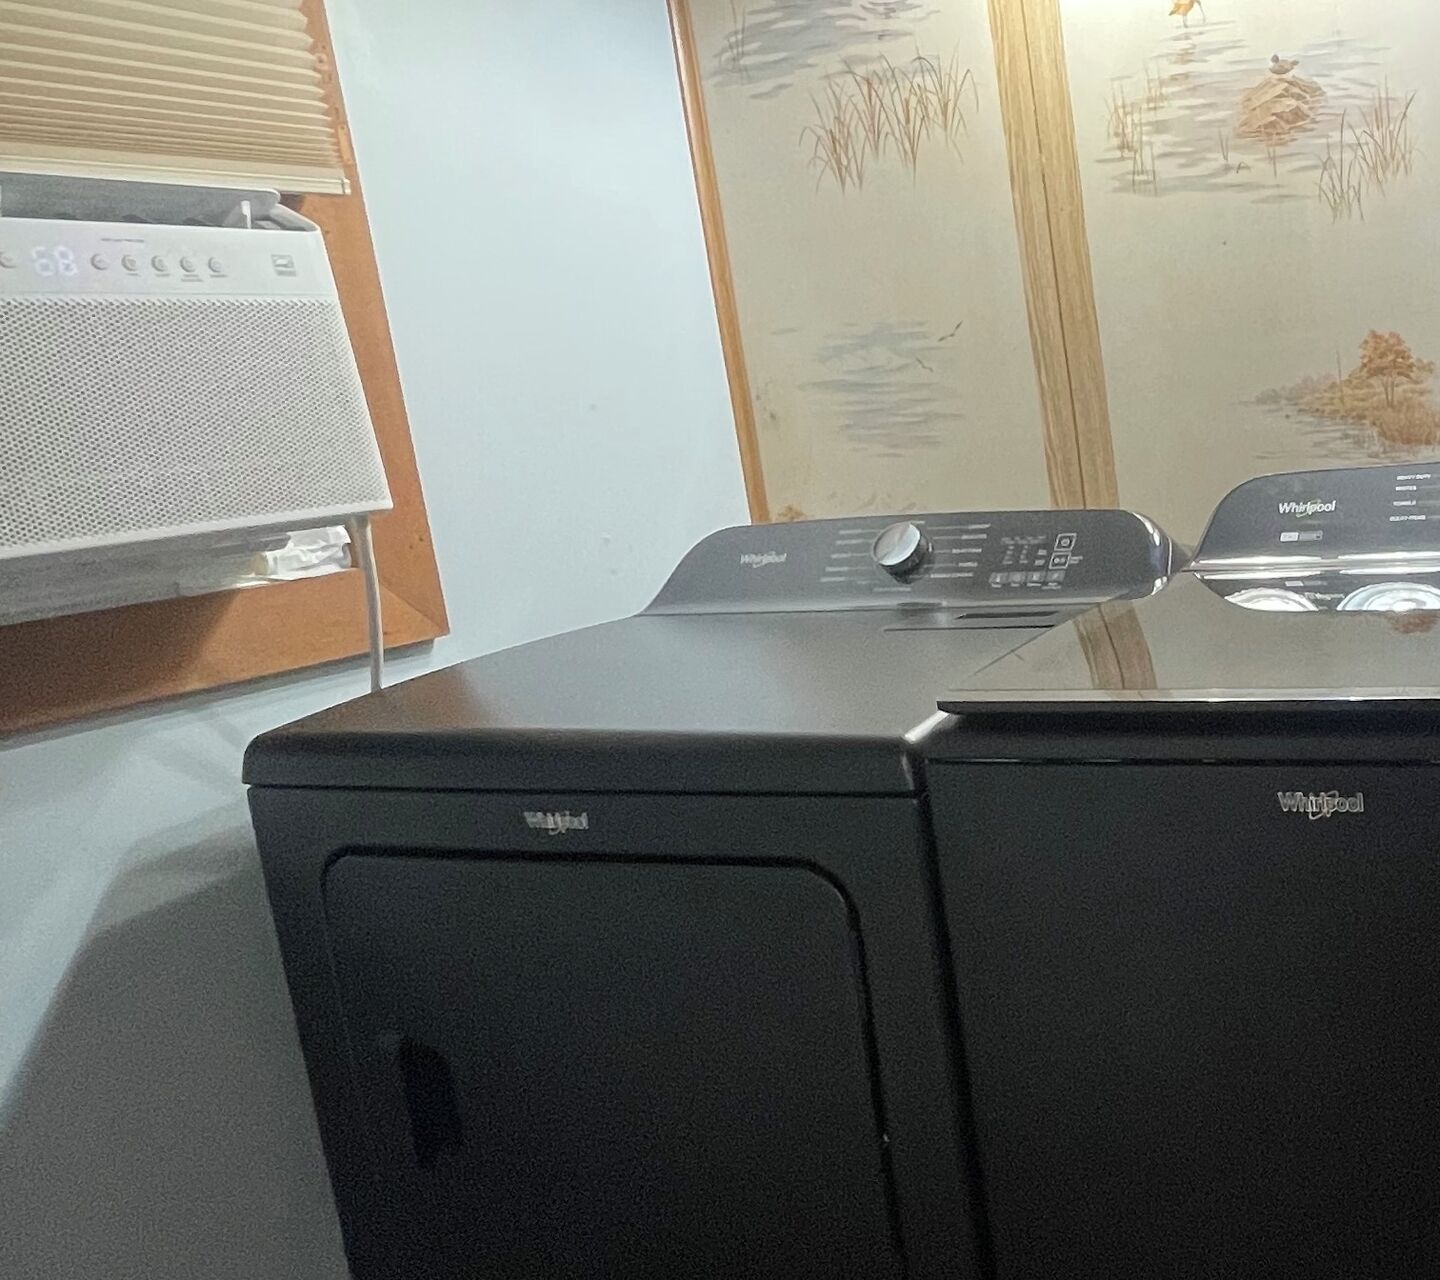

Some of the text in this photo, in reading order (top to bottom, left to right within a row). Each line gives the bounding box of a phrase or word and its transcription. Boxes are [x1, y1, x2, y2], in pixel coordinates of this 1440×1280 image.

[1278, 499, 1337, 518] Whirlpool
[740, 551, 787, 568] Whirlpool
[1277, 790, 1364, 819] Whirlpool
[523, 811, 589, 835] Whirlpool
